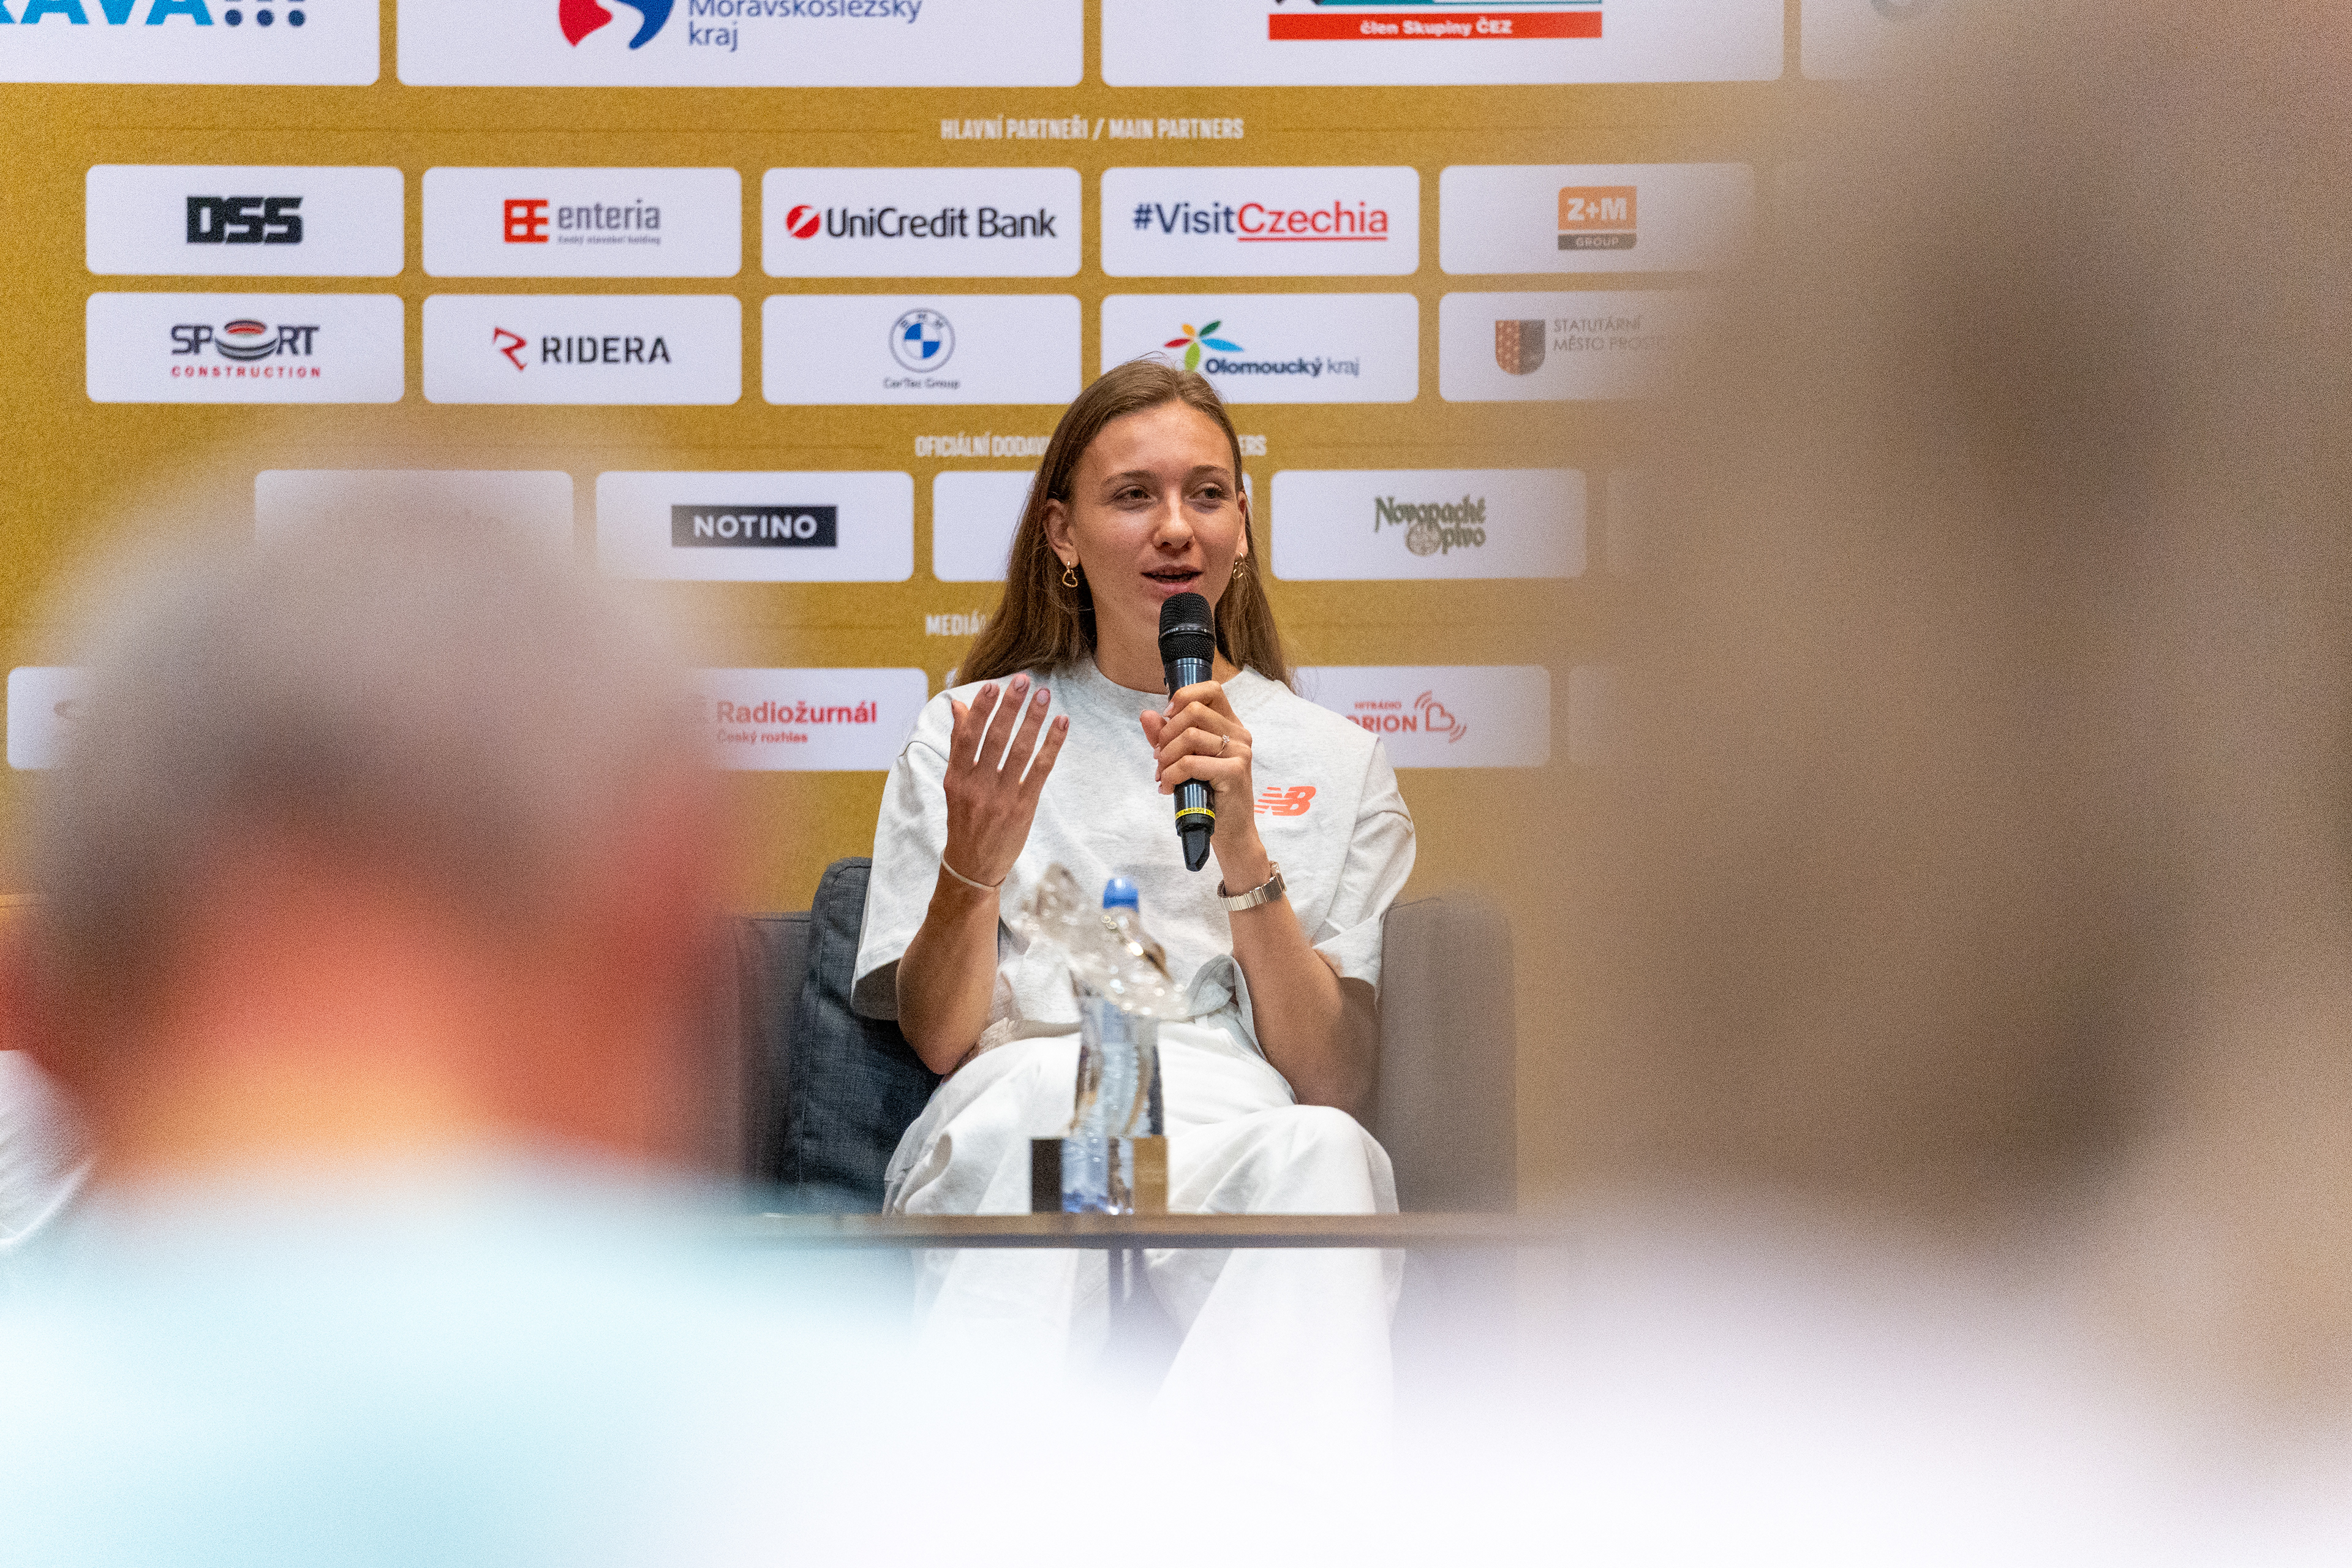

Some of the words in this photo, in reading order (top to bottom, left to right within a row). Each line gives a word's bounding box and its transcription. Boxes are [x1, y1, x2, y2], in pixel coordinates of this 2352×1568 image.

[688, 21, 738, 52] kraj
[1360, 21, 1399, 34] člen
[1403, 20, 1472, 37] Skupiny
[1476, 17, 1513, 34] ČEZ
[941, 115, 1003, 139] HLAVNÍ
[1006, 115, 1088, 139] PARTNEŘI
[1092, 118, 1105, 140] /
[1109, 118, 1154, 138] MAIN
[1157, 118, 1244, 139] PARTNERS
[186, 196, 304, 244] DSS
[557, 199, 661, 230] enteria
[1133, 200, 1389, 236] #VisitCzechia
[1567, 197, 1627, 221] Z+M
[826, 207, 969, 238] UniCredit
[978, 207, 1057, 238] Bank
[1575, 237, 1619, 247] GROUP
[541, 336, 671, 364] RIDERA
[172, 366, 321, 379] CONSTRUCTION
[1205, 358, 1323, 377] Olomoucký
[1327, 358, 1360, 377] kraj
[915, 431, 990, 457] OFICIÁLNÍ
[693, 514, 818, 540] NOTINO
[717, 699, 876, 723] Radiožurnál
[760, 732, 808, 743] rozhlas
